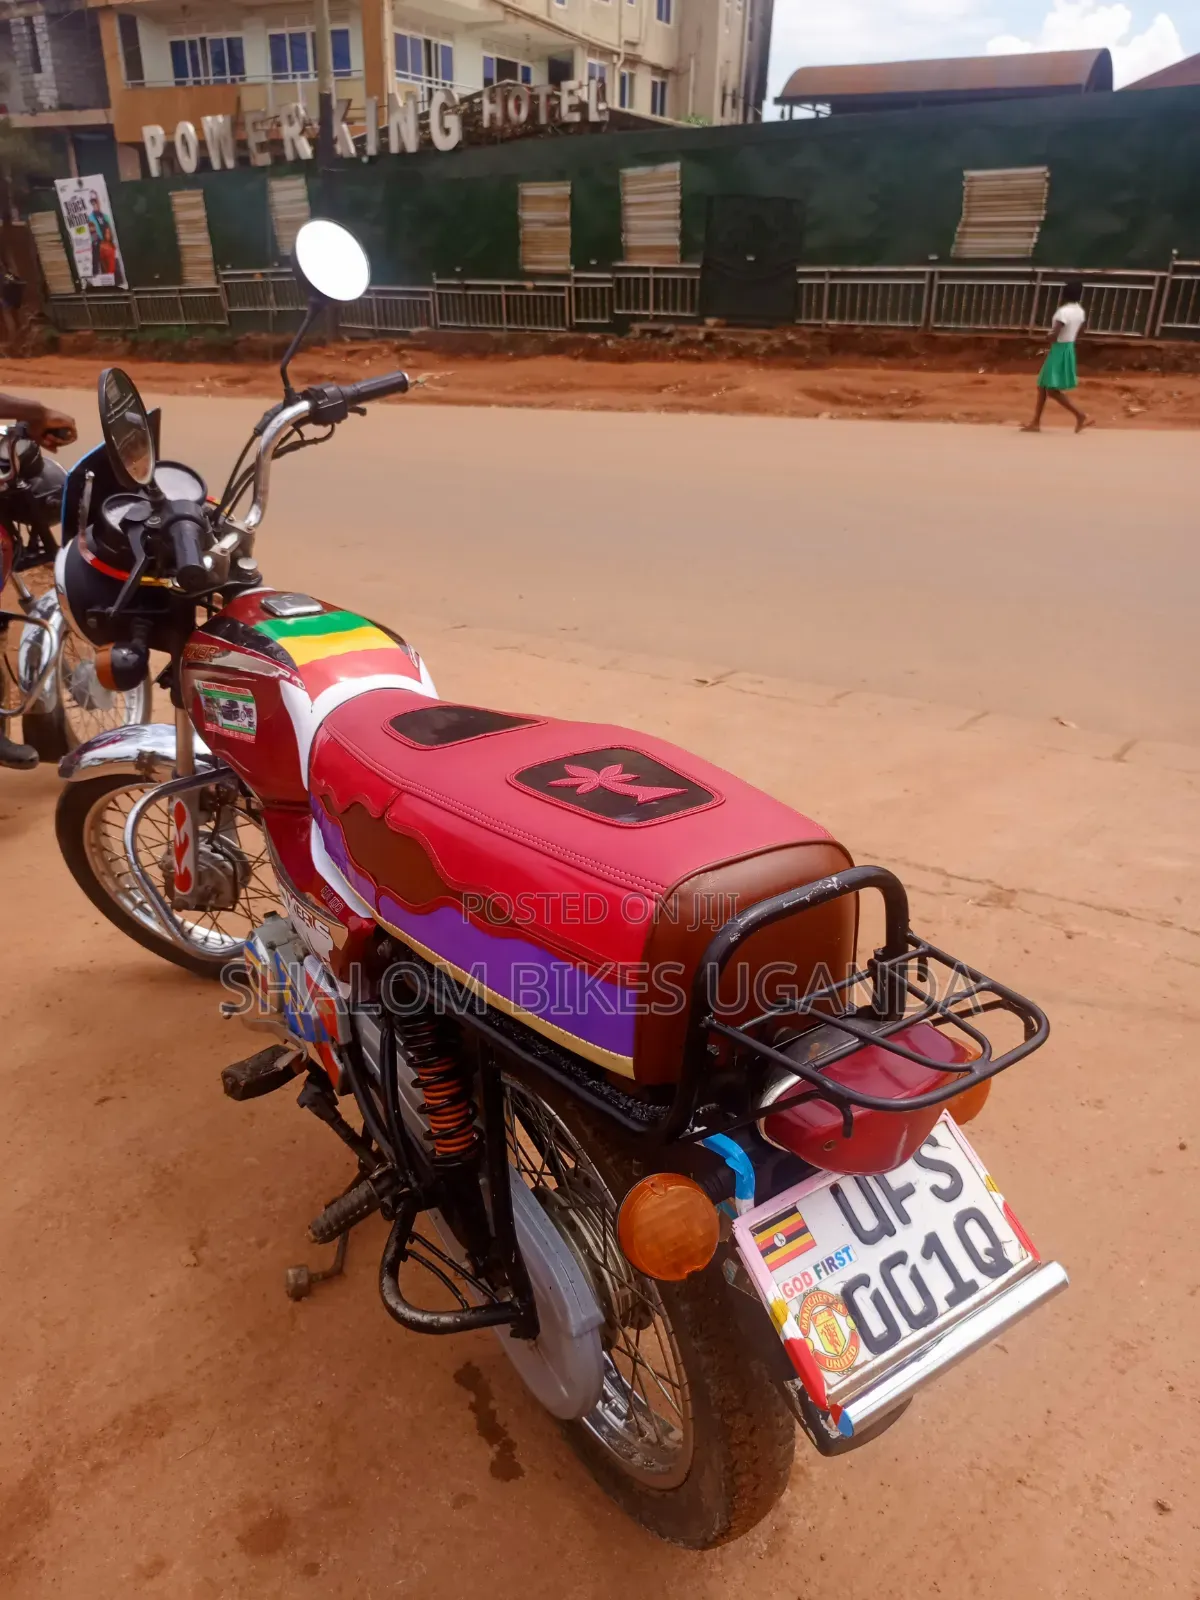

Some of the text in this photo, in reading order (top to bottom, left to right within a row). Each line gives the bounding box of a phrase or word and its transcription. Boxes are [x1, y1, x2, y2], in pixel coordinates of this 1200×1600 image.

[141, 79, 609, 177] POWER KING HOTEL
[829, 1134, 964, 1245] UFS
[782, 1245, 854, 1300] GOD FIRST
[825, 1345, 857, 1369] UNITED
